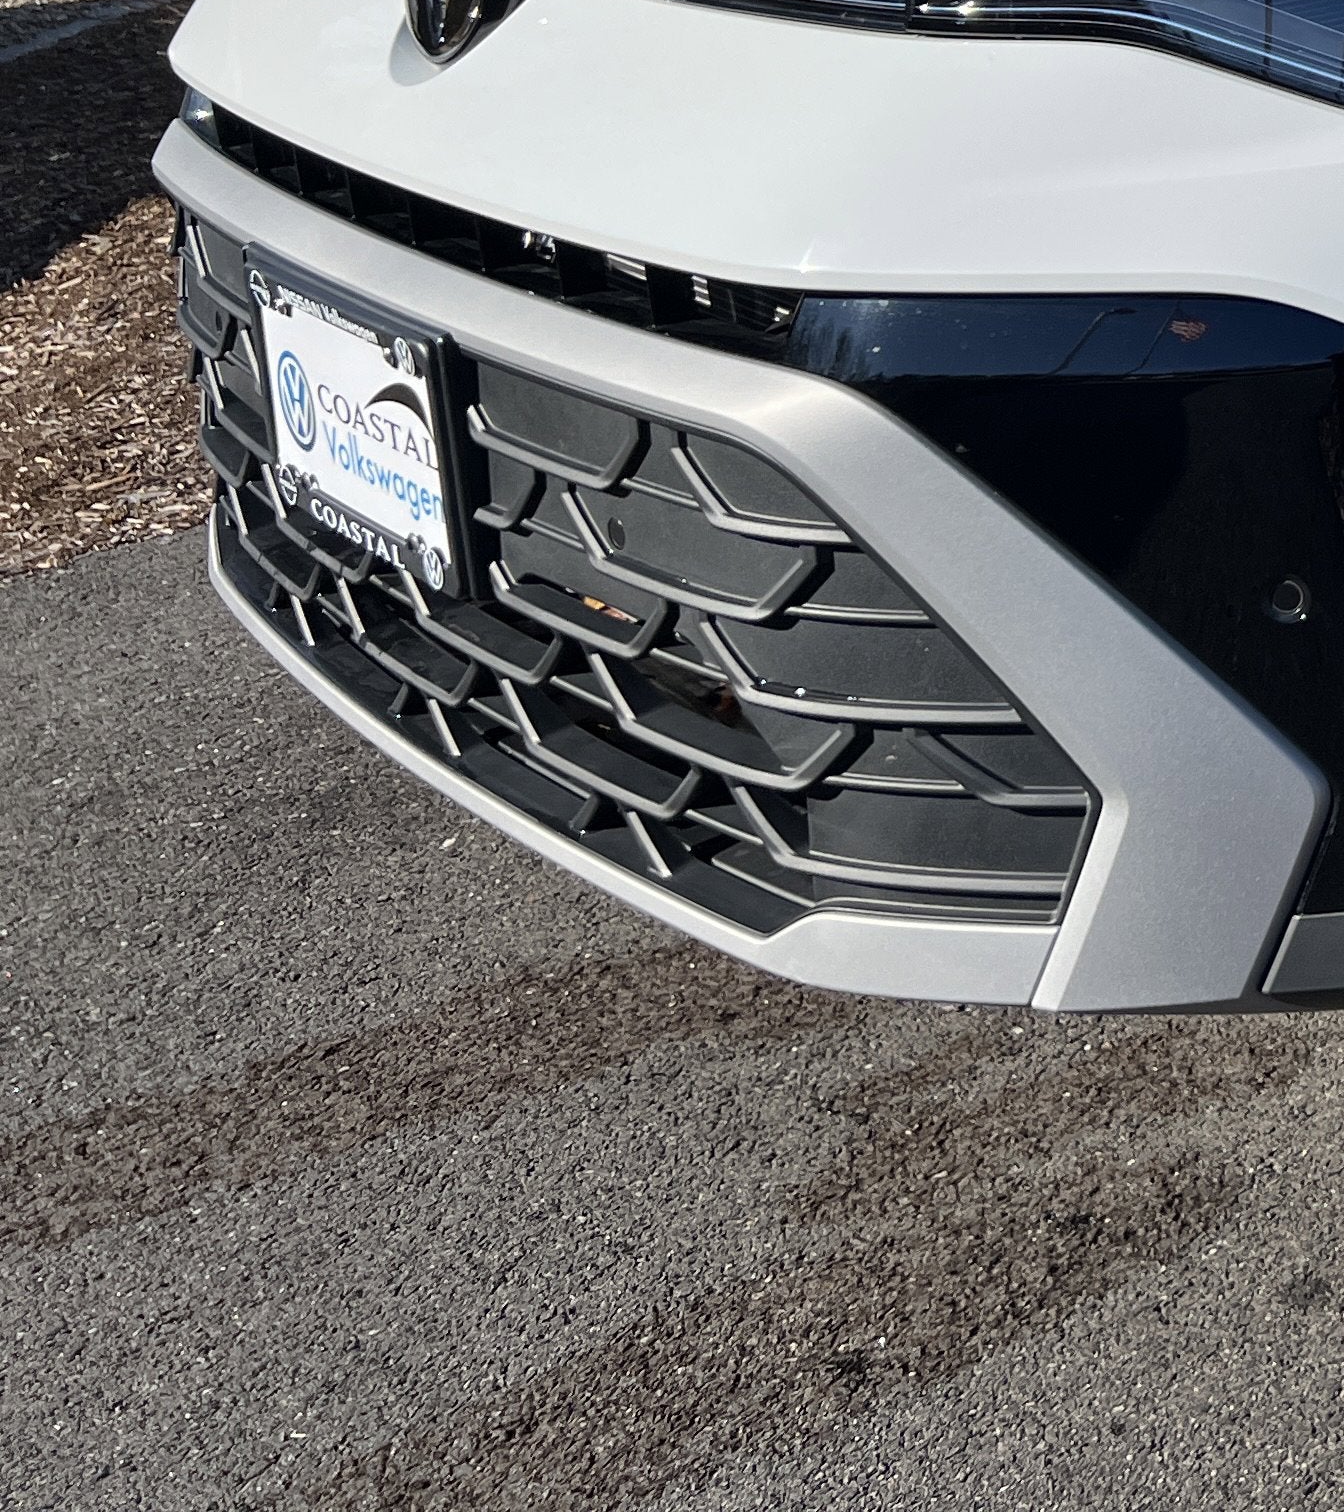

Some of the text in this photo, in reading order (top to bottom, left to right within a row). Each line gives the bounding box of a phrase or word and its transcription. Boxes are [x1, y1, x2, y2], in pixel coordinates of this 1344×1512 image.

[317, 383, 439, 470] COASTAL
[322, 421, 445, 523] Volkswagen
[310, 495, 406, 571] COASTAL
